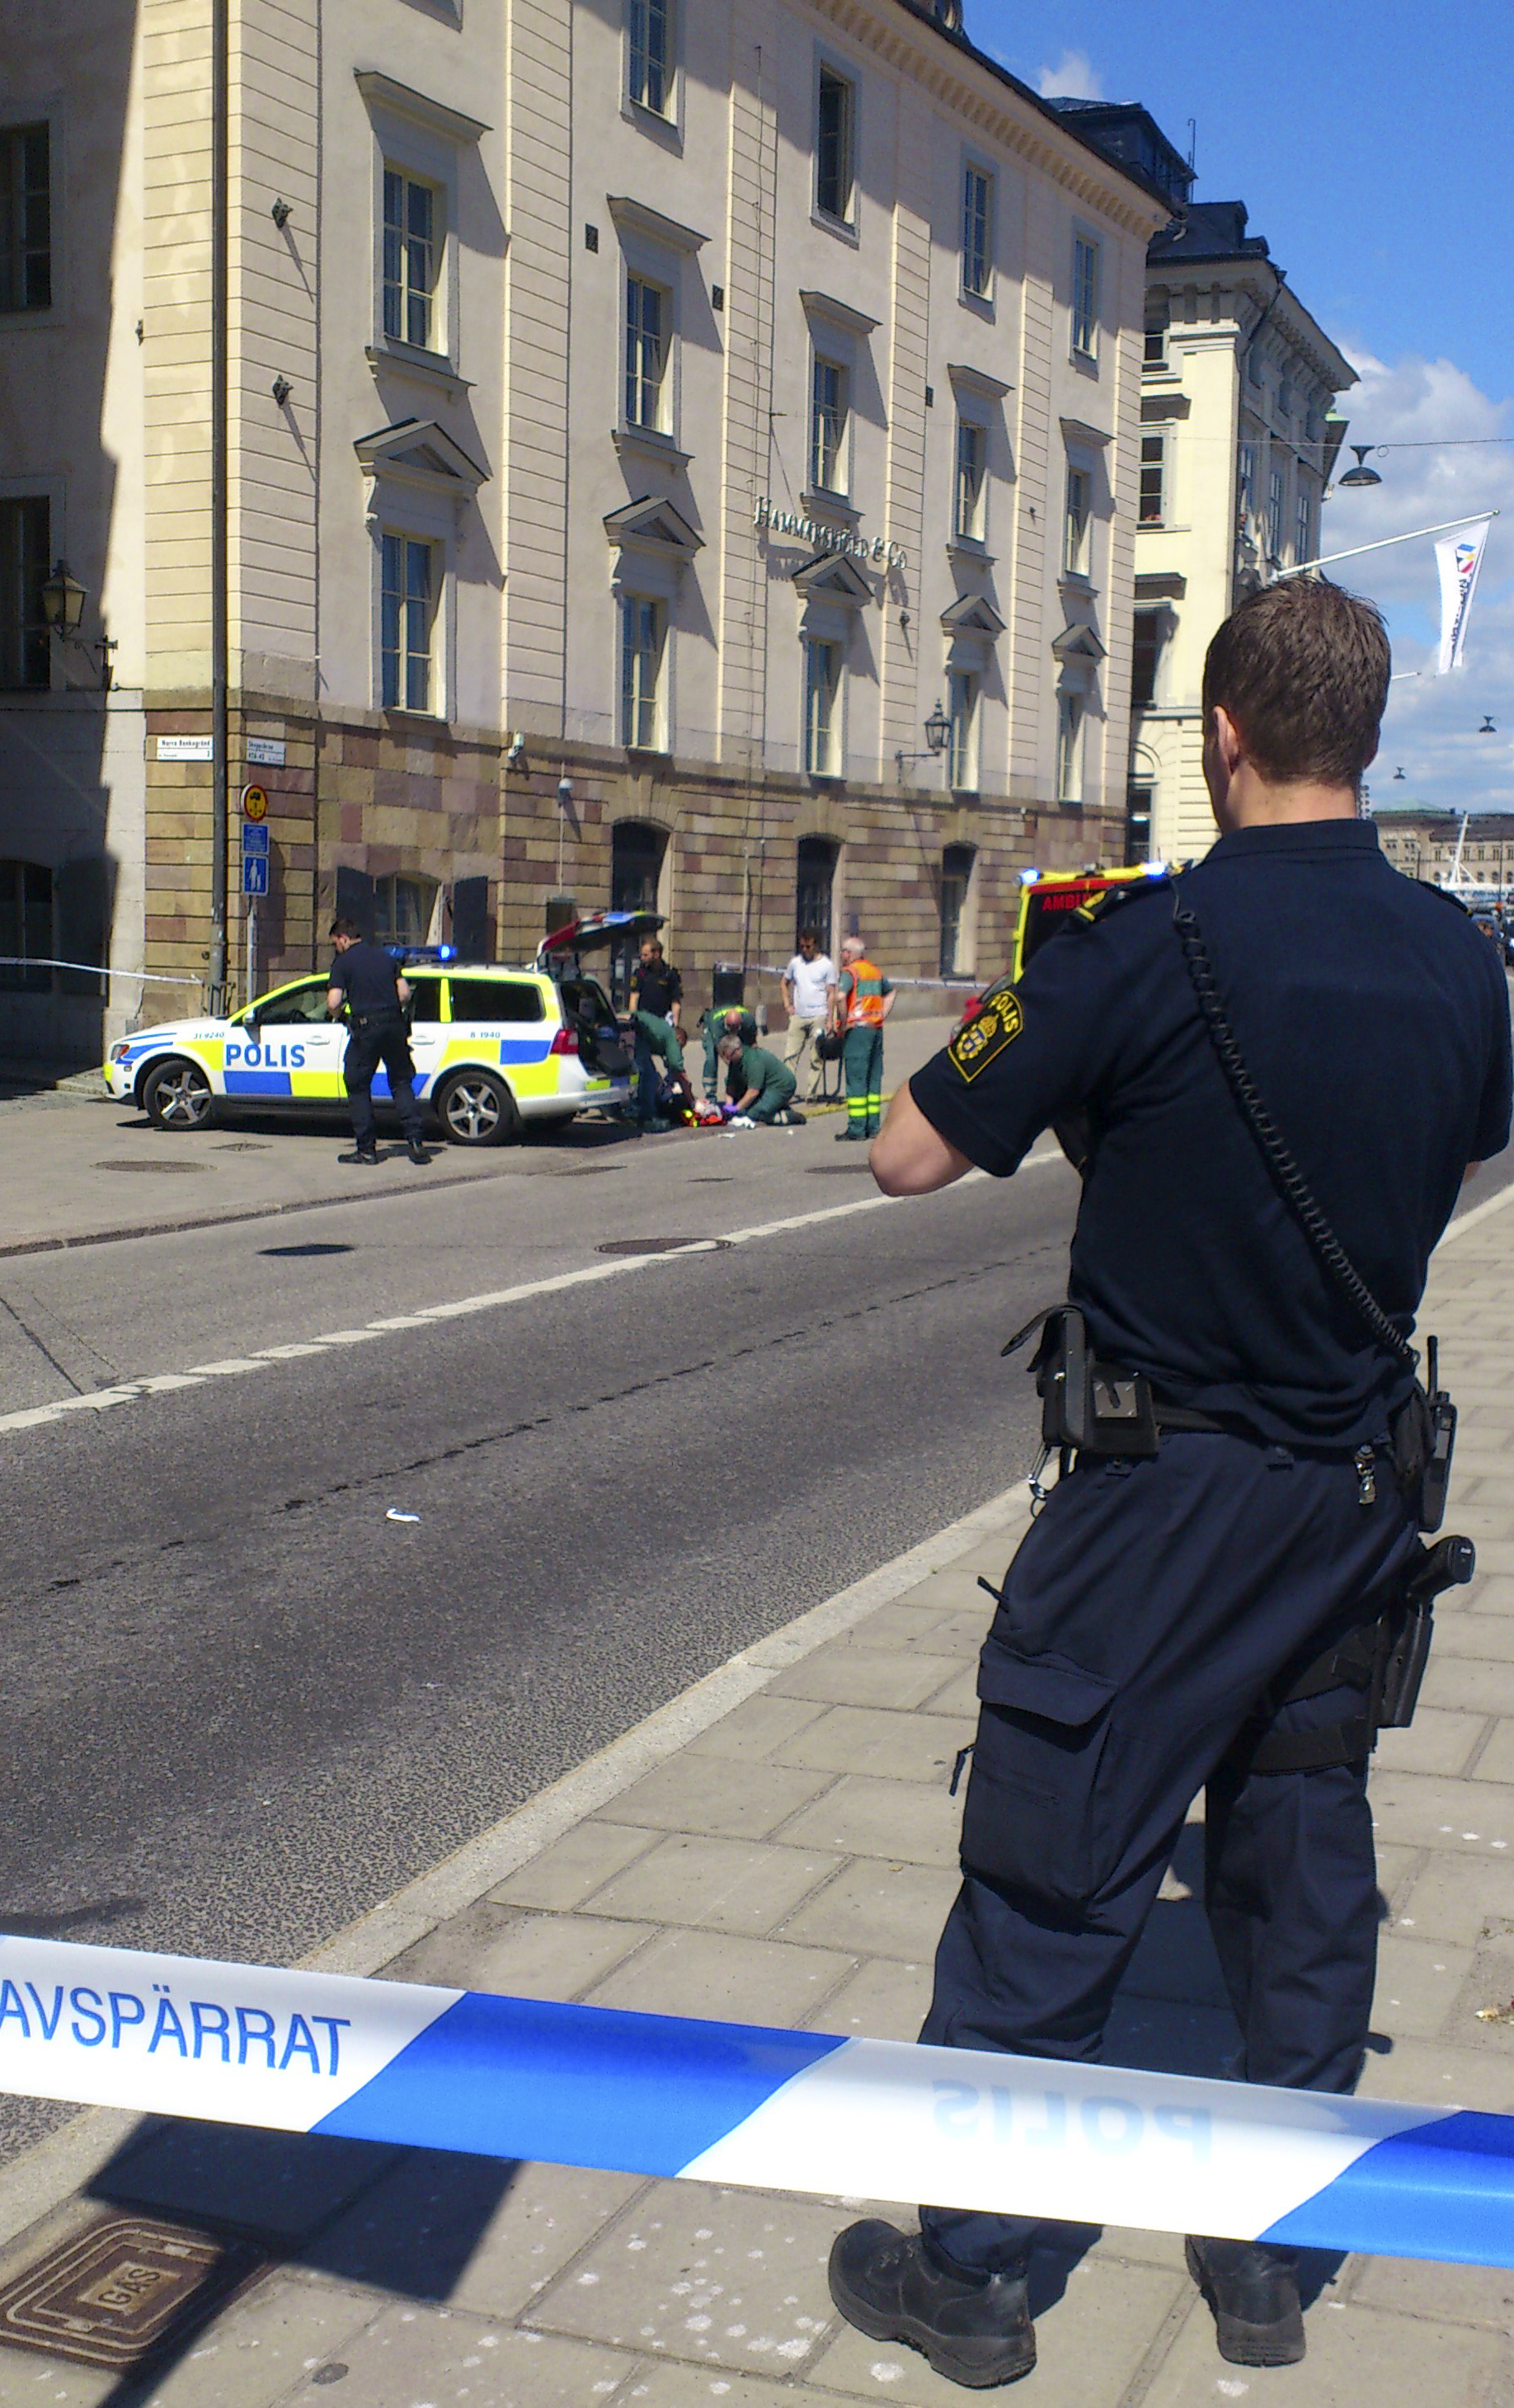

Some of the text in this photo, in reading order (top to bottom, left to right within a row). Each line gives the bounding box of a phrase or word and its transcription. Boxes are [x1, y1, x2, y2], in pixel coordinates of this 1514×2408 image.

[988, 995, 1019, 1033] POLIS
[225, 1043, 305, 1068] POLIS
[0, 1979, 352, 2076] AVSPÄRRAT
[97, 2267, 162, 2307] GAS
